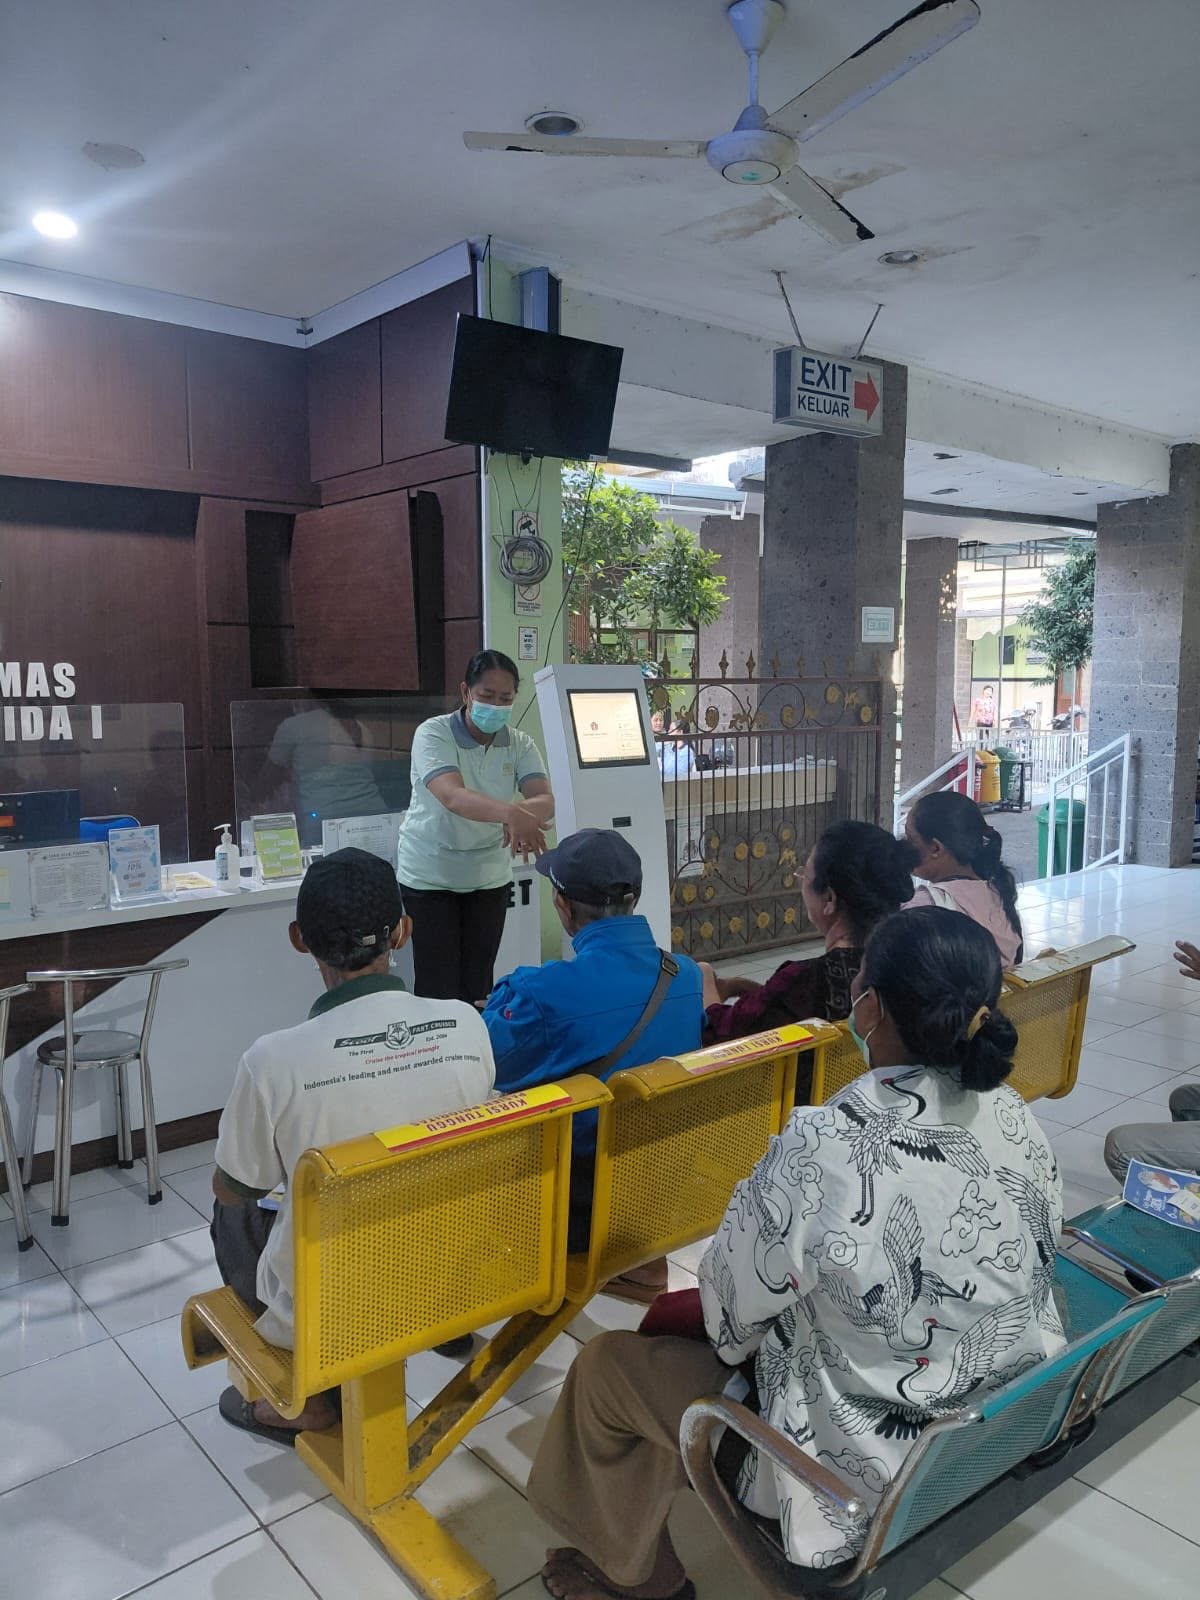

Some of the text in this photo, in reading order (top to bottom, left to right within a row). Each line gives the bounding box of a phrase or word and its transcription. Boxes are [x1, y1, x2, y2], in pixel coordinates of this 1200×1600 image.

[801, 356, 852, 393] EXIT
[797, 394, 850, 418] KELUAR
[3, 705, 103, 741] IDA I
[430, 1020, 456, 1029] CRUISES
[365, 1057, 384, 1065] Cruise
[417, 1044, 440, 1055] triangle
[304, 1074, 346, 1091] Indonesia's
[348, 1071, 376, 1081] leading
[377, 1066, 391, 1076] and
[393, 1063, 411, 1073] most
[413, 1056, 443, 1069] awarded
[426, 1098, 528, 1132] KURSI TUNGGU
